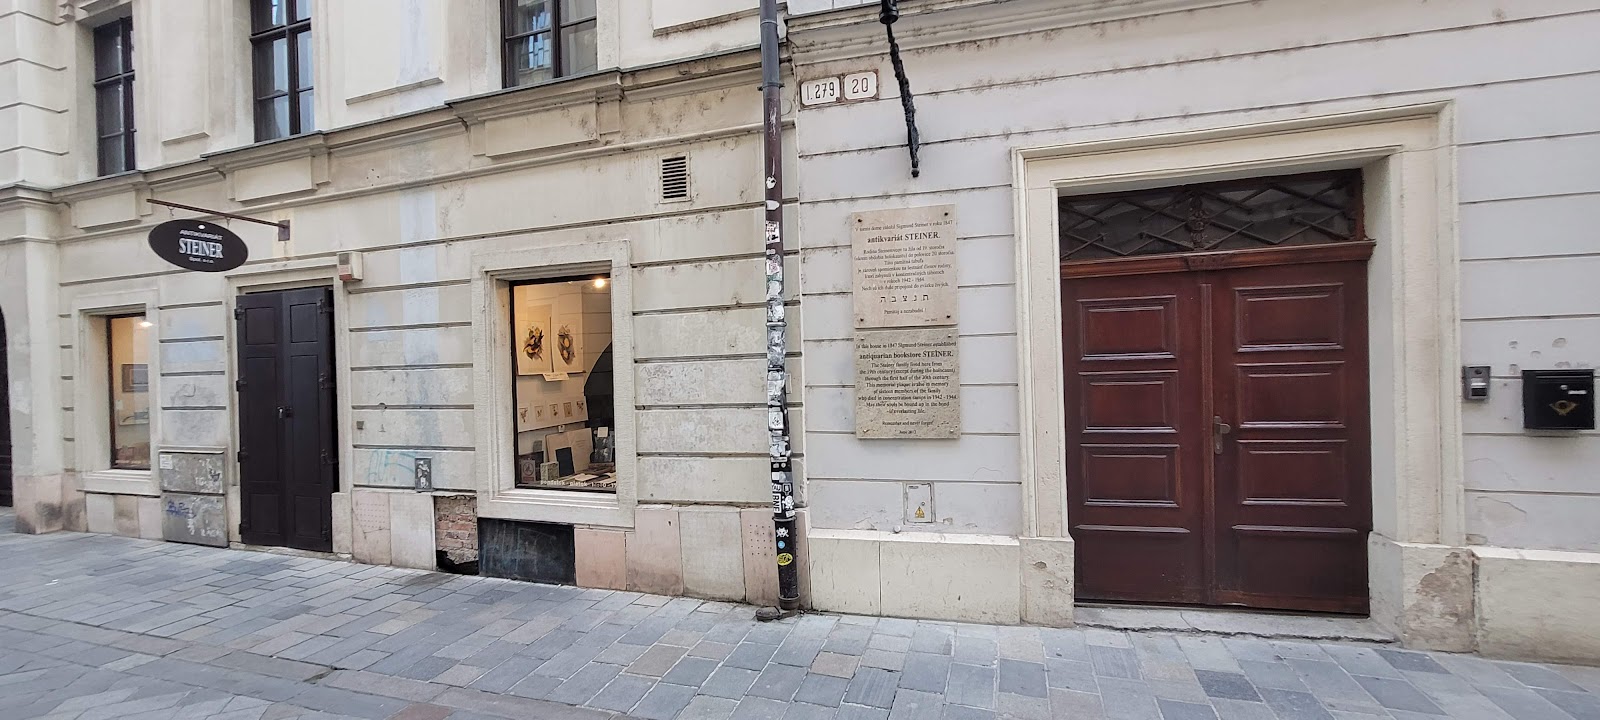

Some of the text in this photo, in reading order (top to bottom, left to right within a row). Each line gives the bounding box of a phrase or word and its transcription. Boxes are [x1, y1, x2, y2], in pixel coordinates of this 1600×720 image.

[852, 78, 868, 94] 20
[867, 232, 941, 244] antikvariát STEINER.
[178, 238, 224, 258] STEINER
[860, 352, 892, 360] antiquarian
[922, 350, 954, 358] STEINER.
